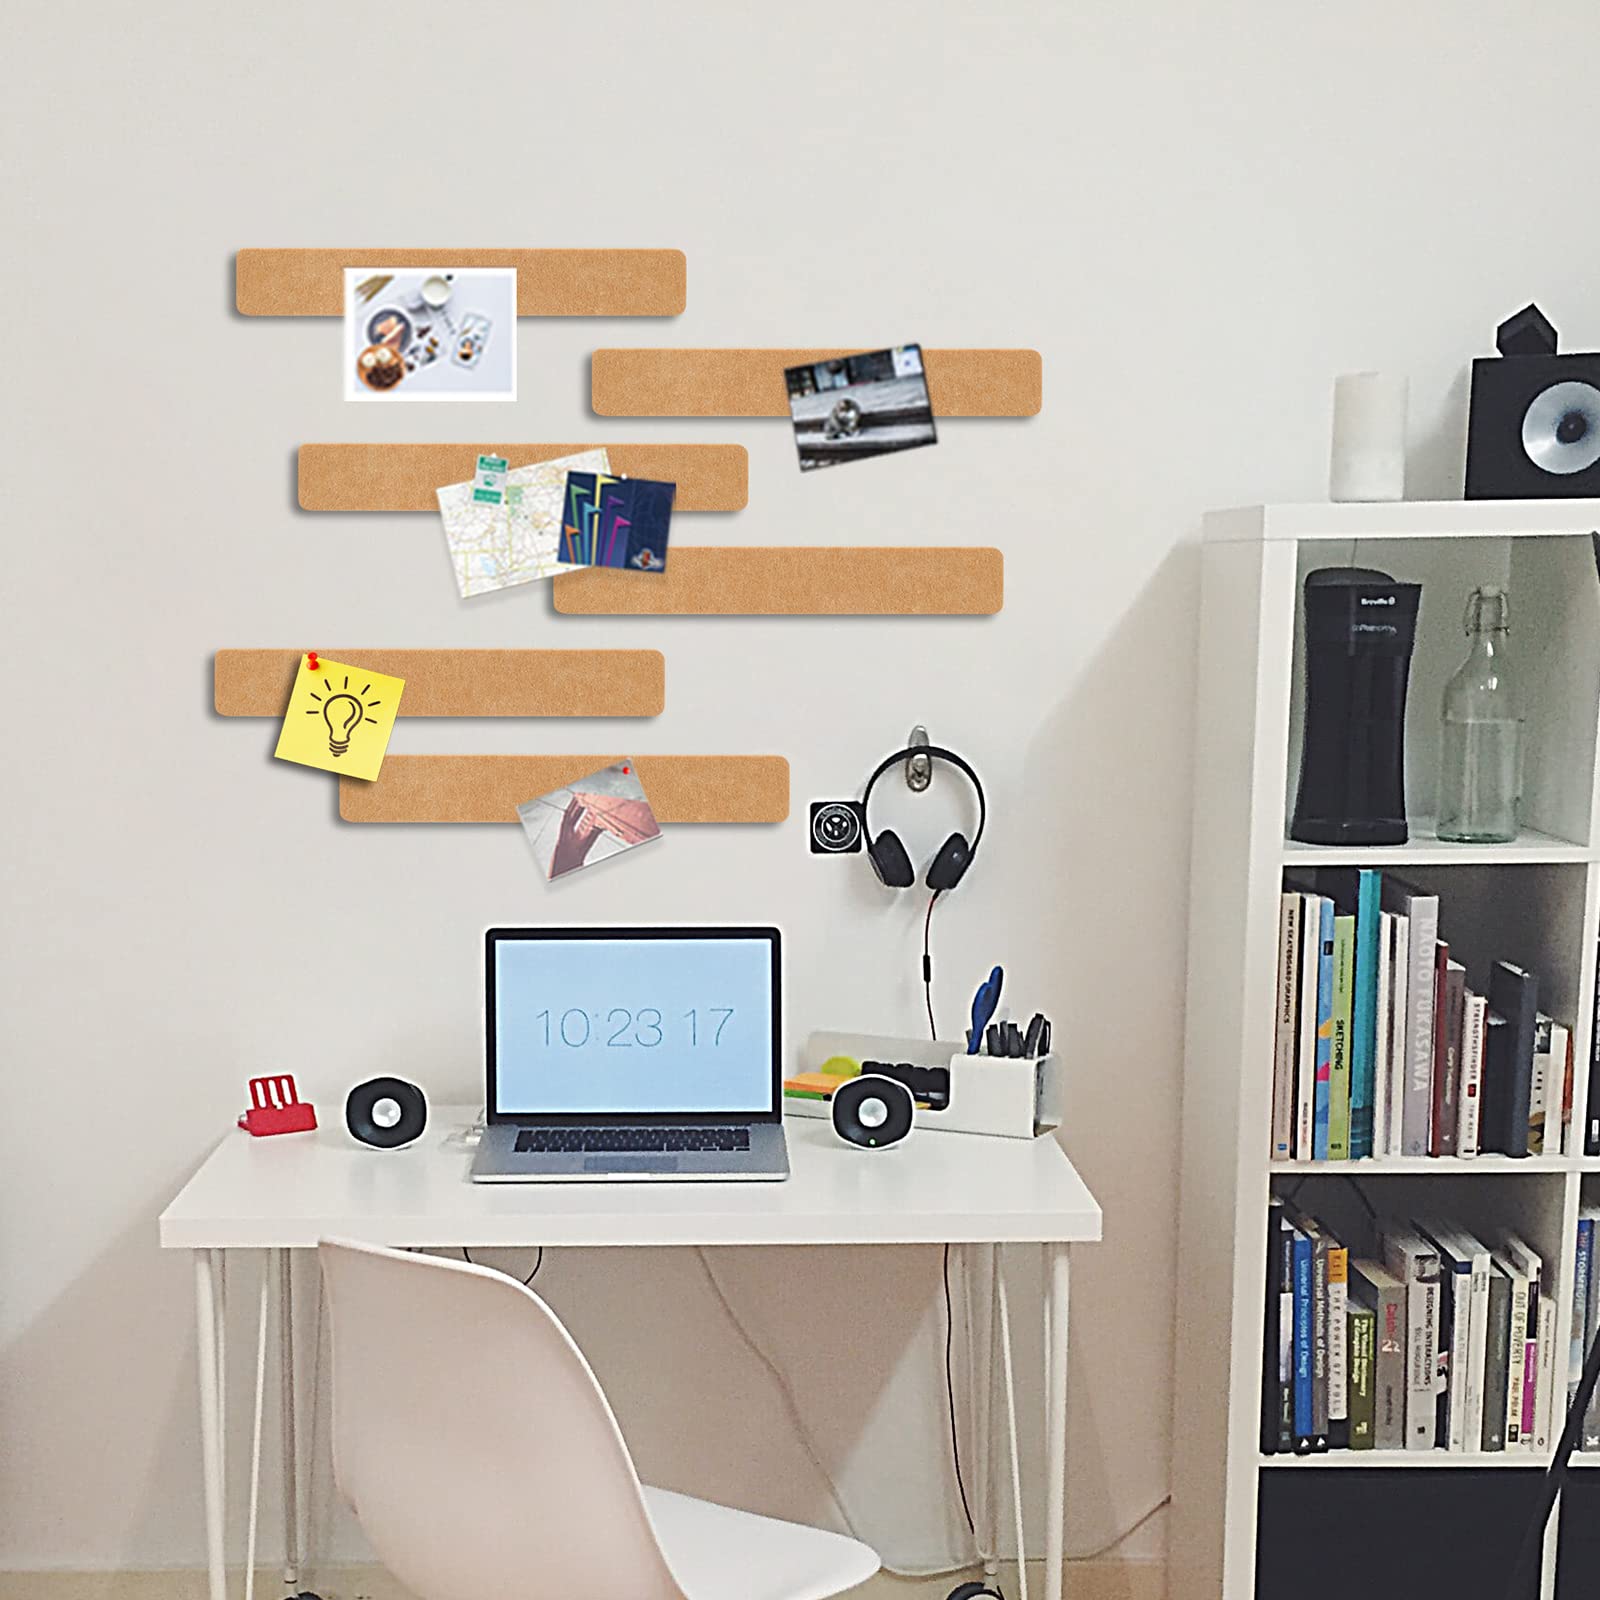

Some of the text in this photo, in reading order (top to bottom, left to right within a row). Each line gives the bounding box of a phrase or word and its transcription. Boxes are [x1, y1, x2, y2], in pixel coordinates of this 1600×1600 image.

[1284, 929, 1294, 981] SKATEBOARD
[1283, 983, 1292, 1024] GRAPHICS
[1412, 918, 1434, 1092] NAOTO FUKASAWA
[683, 1008, 735, 1047] 17
[1334, 1020, 1345, 1070] SKETCHING
[1300, 1260, 1309, 1296] Universal
[1316, 1259, 1325, 1299] Universal
[1299, 1298, 1309, 1339] Principles
[1316, 1301, 1325, 1337] Methods
[1516, 1292, 1526, 1309] OUT
[1516, 1312, 1525, 1323] OF
[1301, 1341, 1308, 1349] of
[1316, 1338, 1325, 1347] of
[1424, 1287, 1434, 1386] DESIGNING INTERACTIONS
[1512, 1326, 1524, 1364] POVERTY
[1299, 1351, 1308, 1378] Design
[1315, 1349, 1324, 1378] Design
[1359, 1358, 1367, 1396] Dictionary
